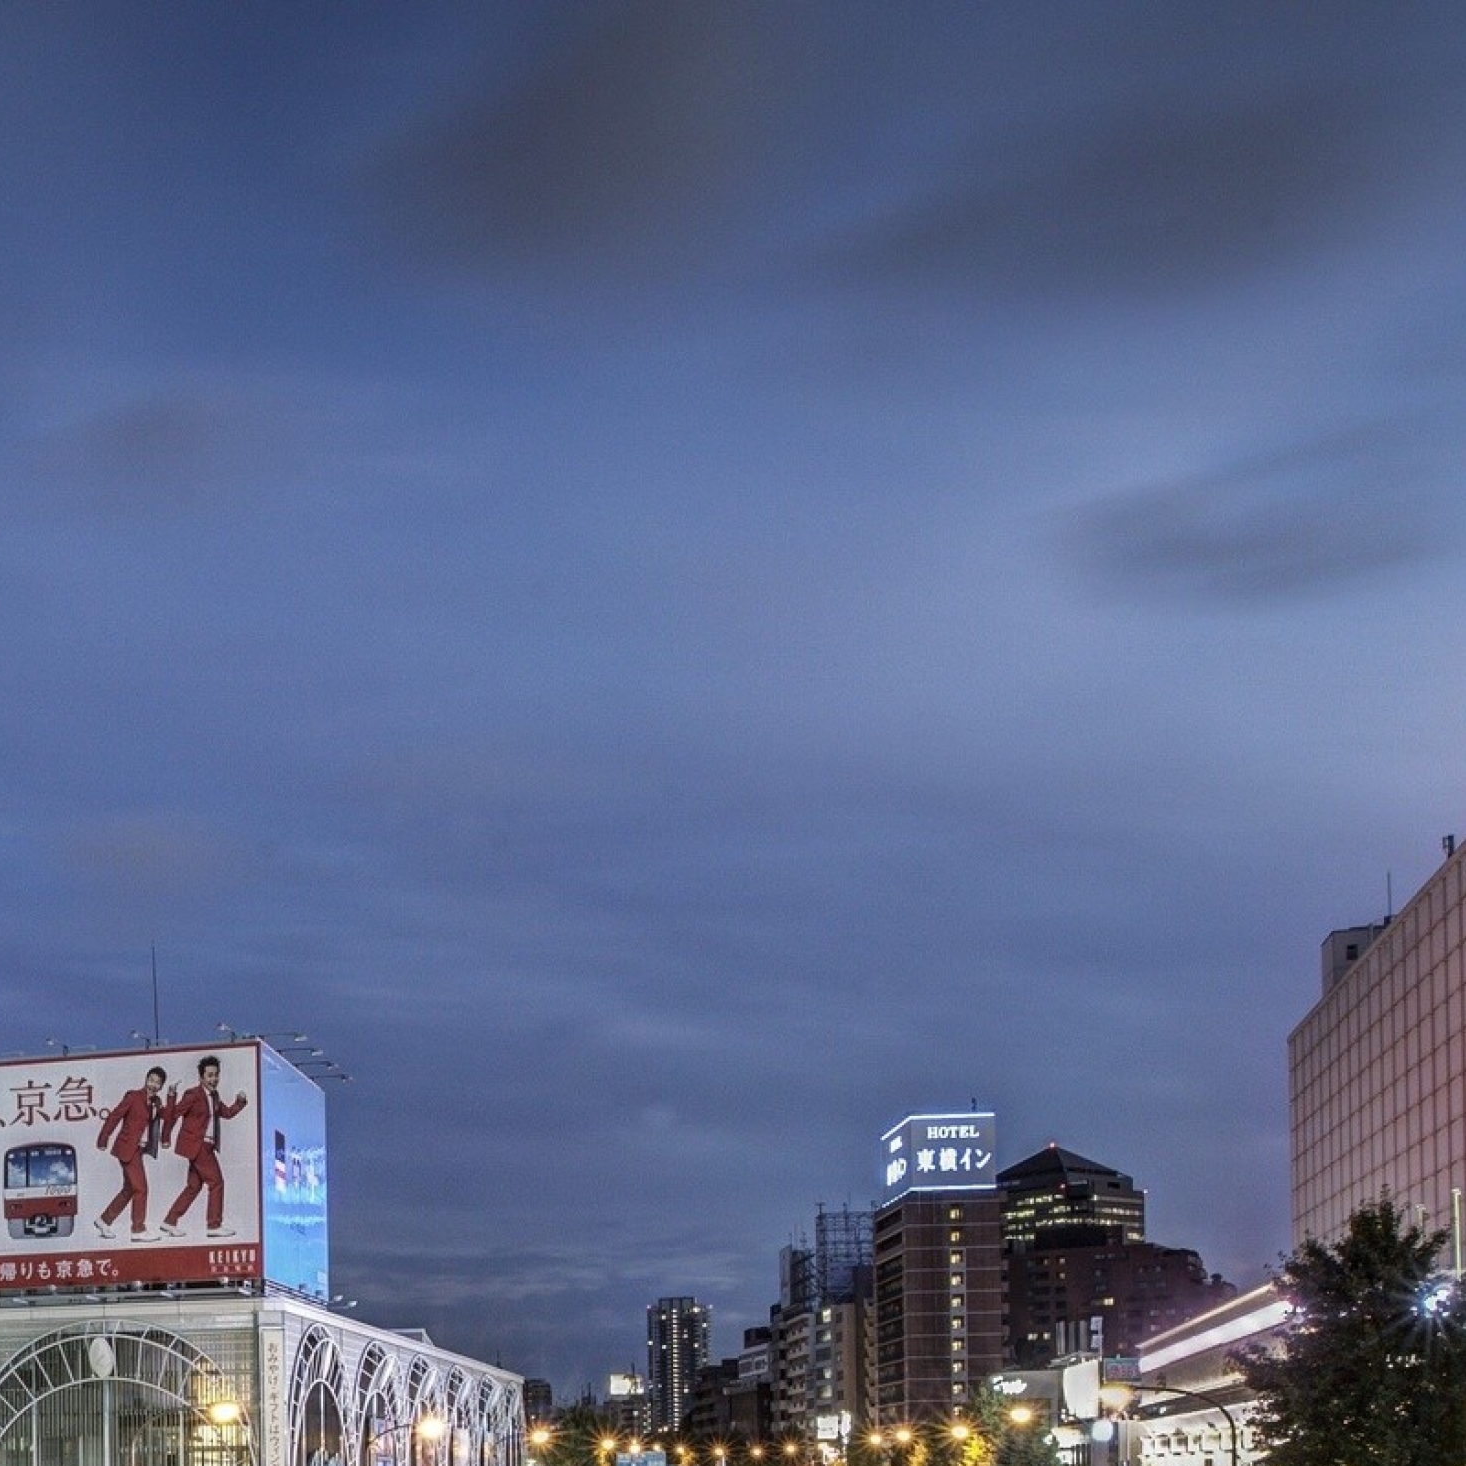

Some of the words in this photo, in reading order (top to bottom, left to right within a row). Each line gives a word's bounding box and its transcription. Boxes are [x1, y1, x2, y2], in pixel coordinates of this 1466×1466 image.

[926, 1125, 980, 1139] HOTEL
[916, 1147, 992, 1173] 東横イン
[208, 1249, 256, 1264] KEIKYU
